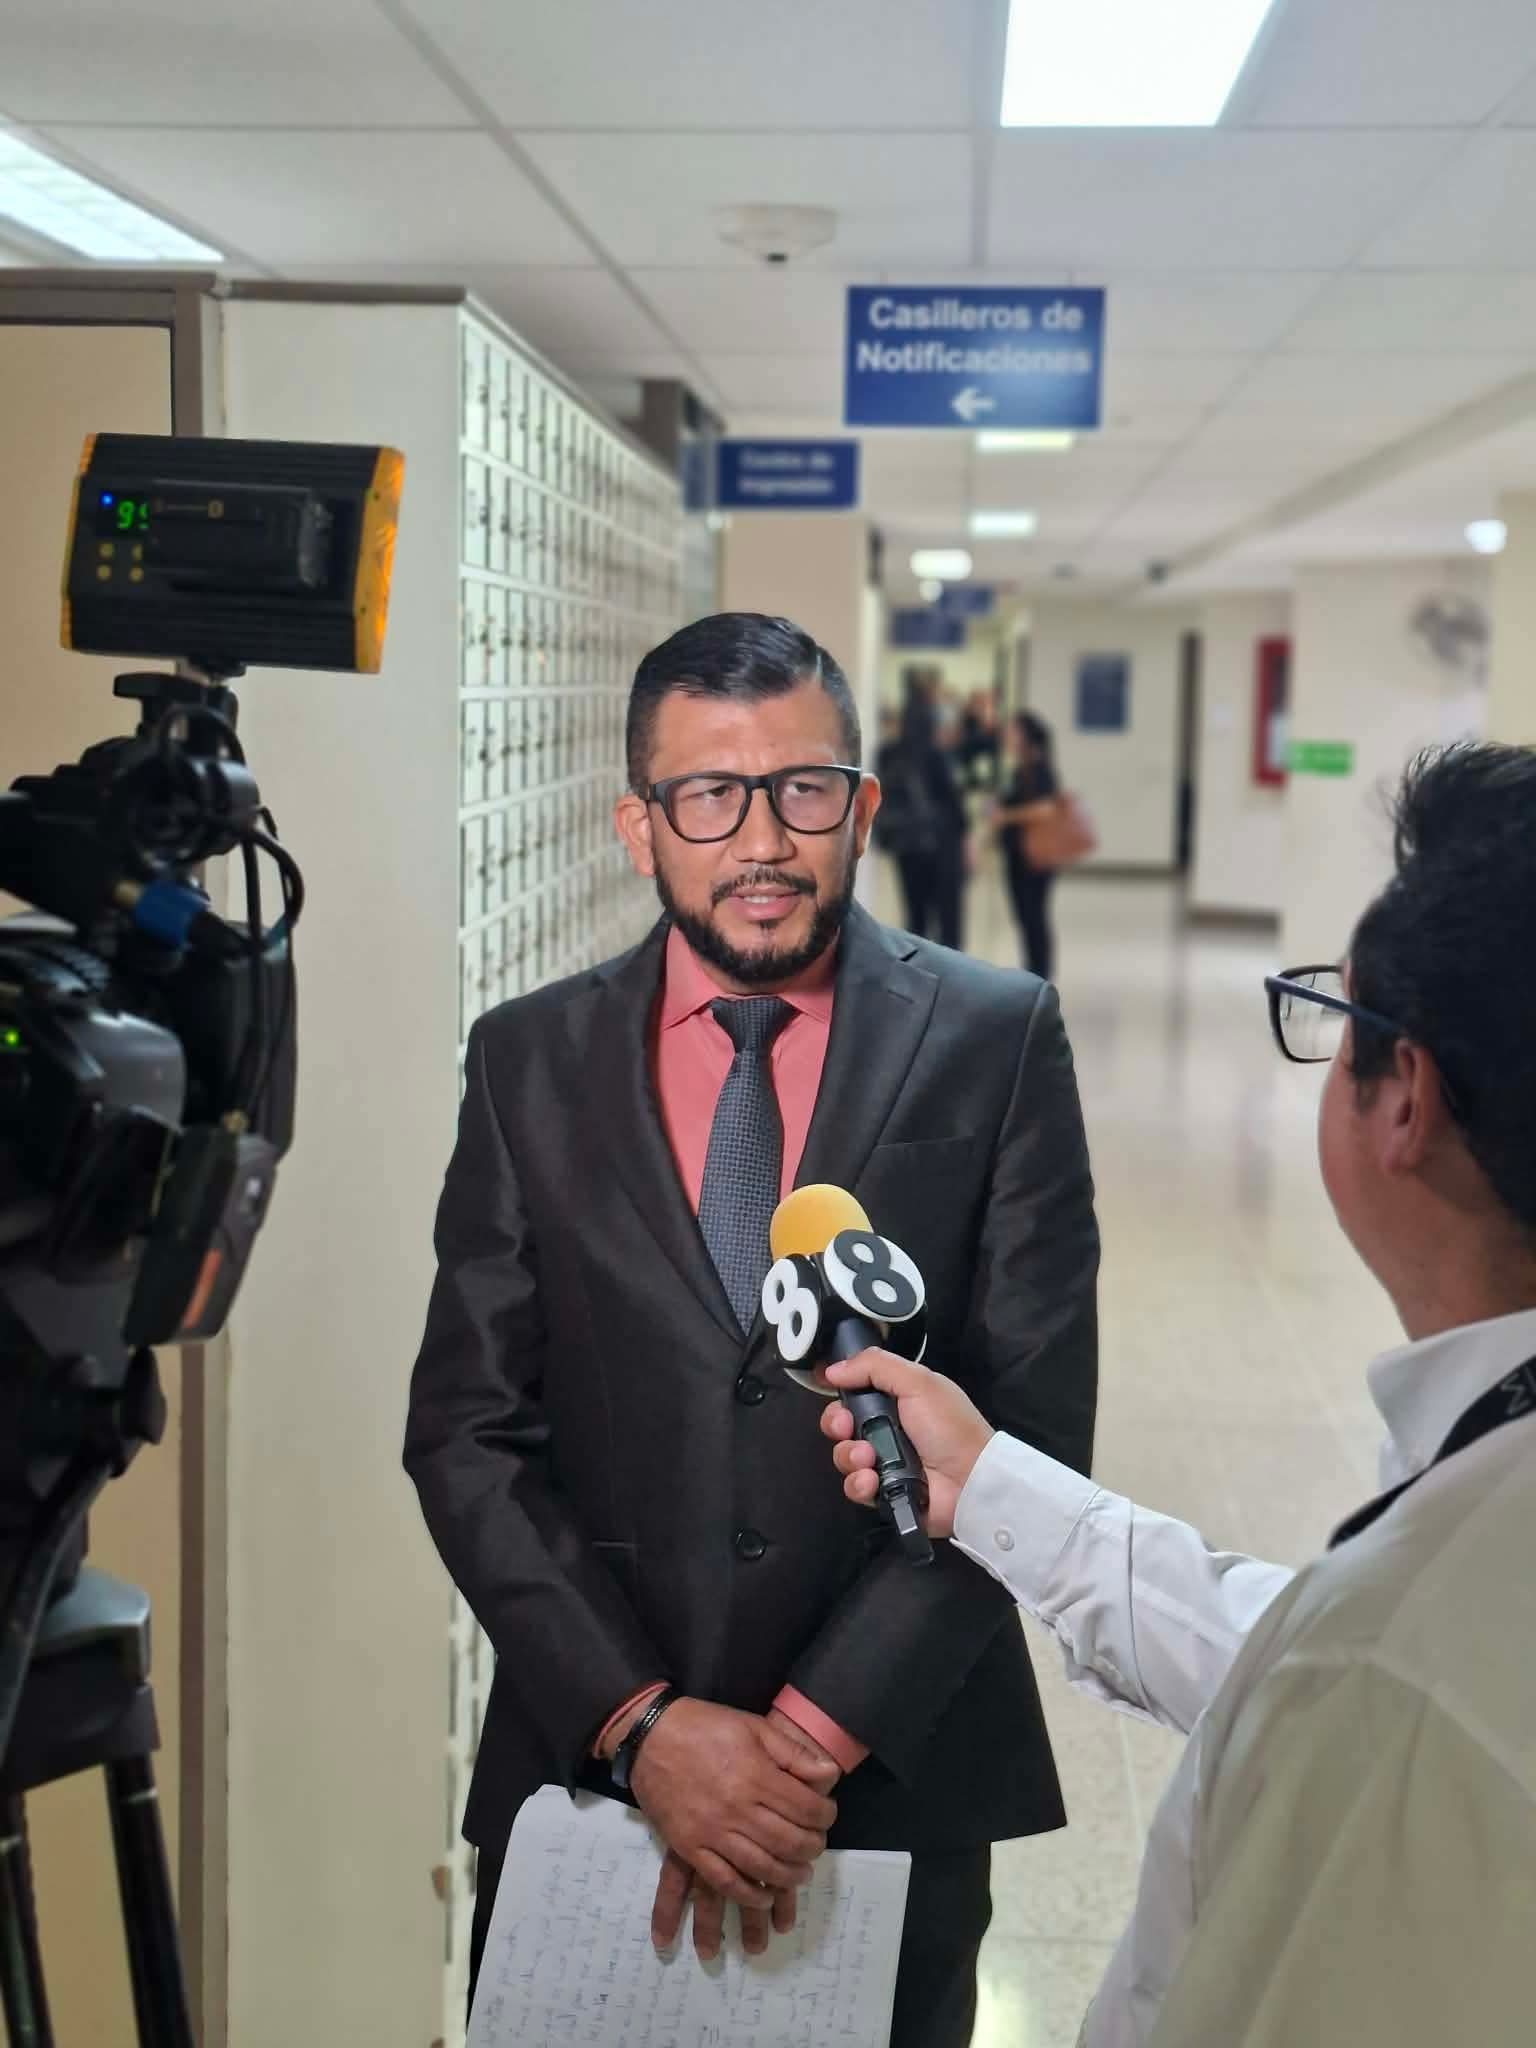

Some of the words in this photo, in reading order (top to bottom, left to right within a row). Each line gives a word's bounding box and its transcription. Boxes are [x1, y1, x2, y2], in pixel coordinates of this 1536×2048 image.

[868, 298, 1031, 330] Casilleros
[1041, 301, 1084, 331] de
[857, 340, 1091, 374] Notificaciones
[833, 1229, 918, 1318] 8
[762, 1258, 819, 1361] 8
